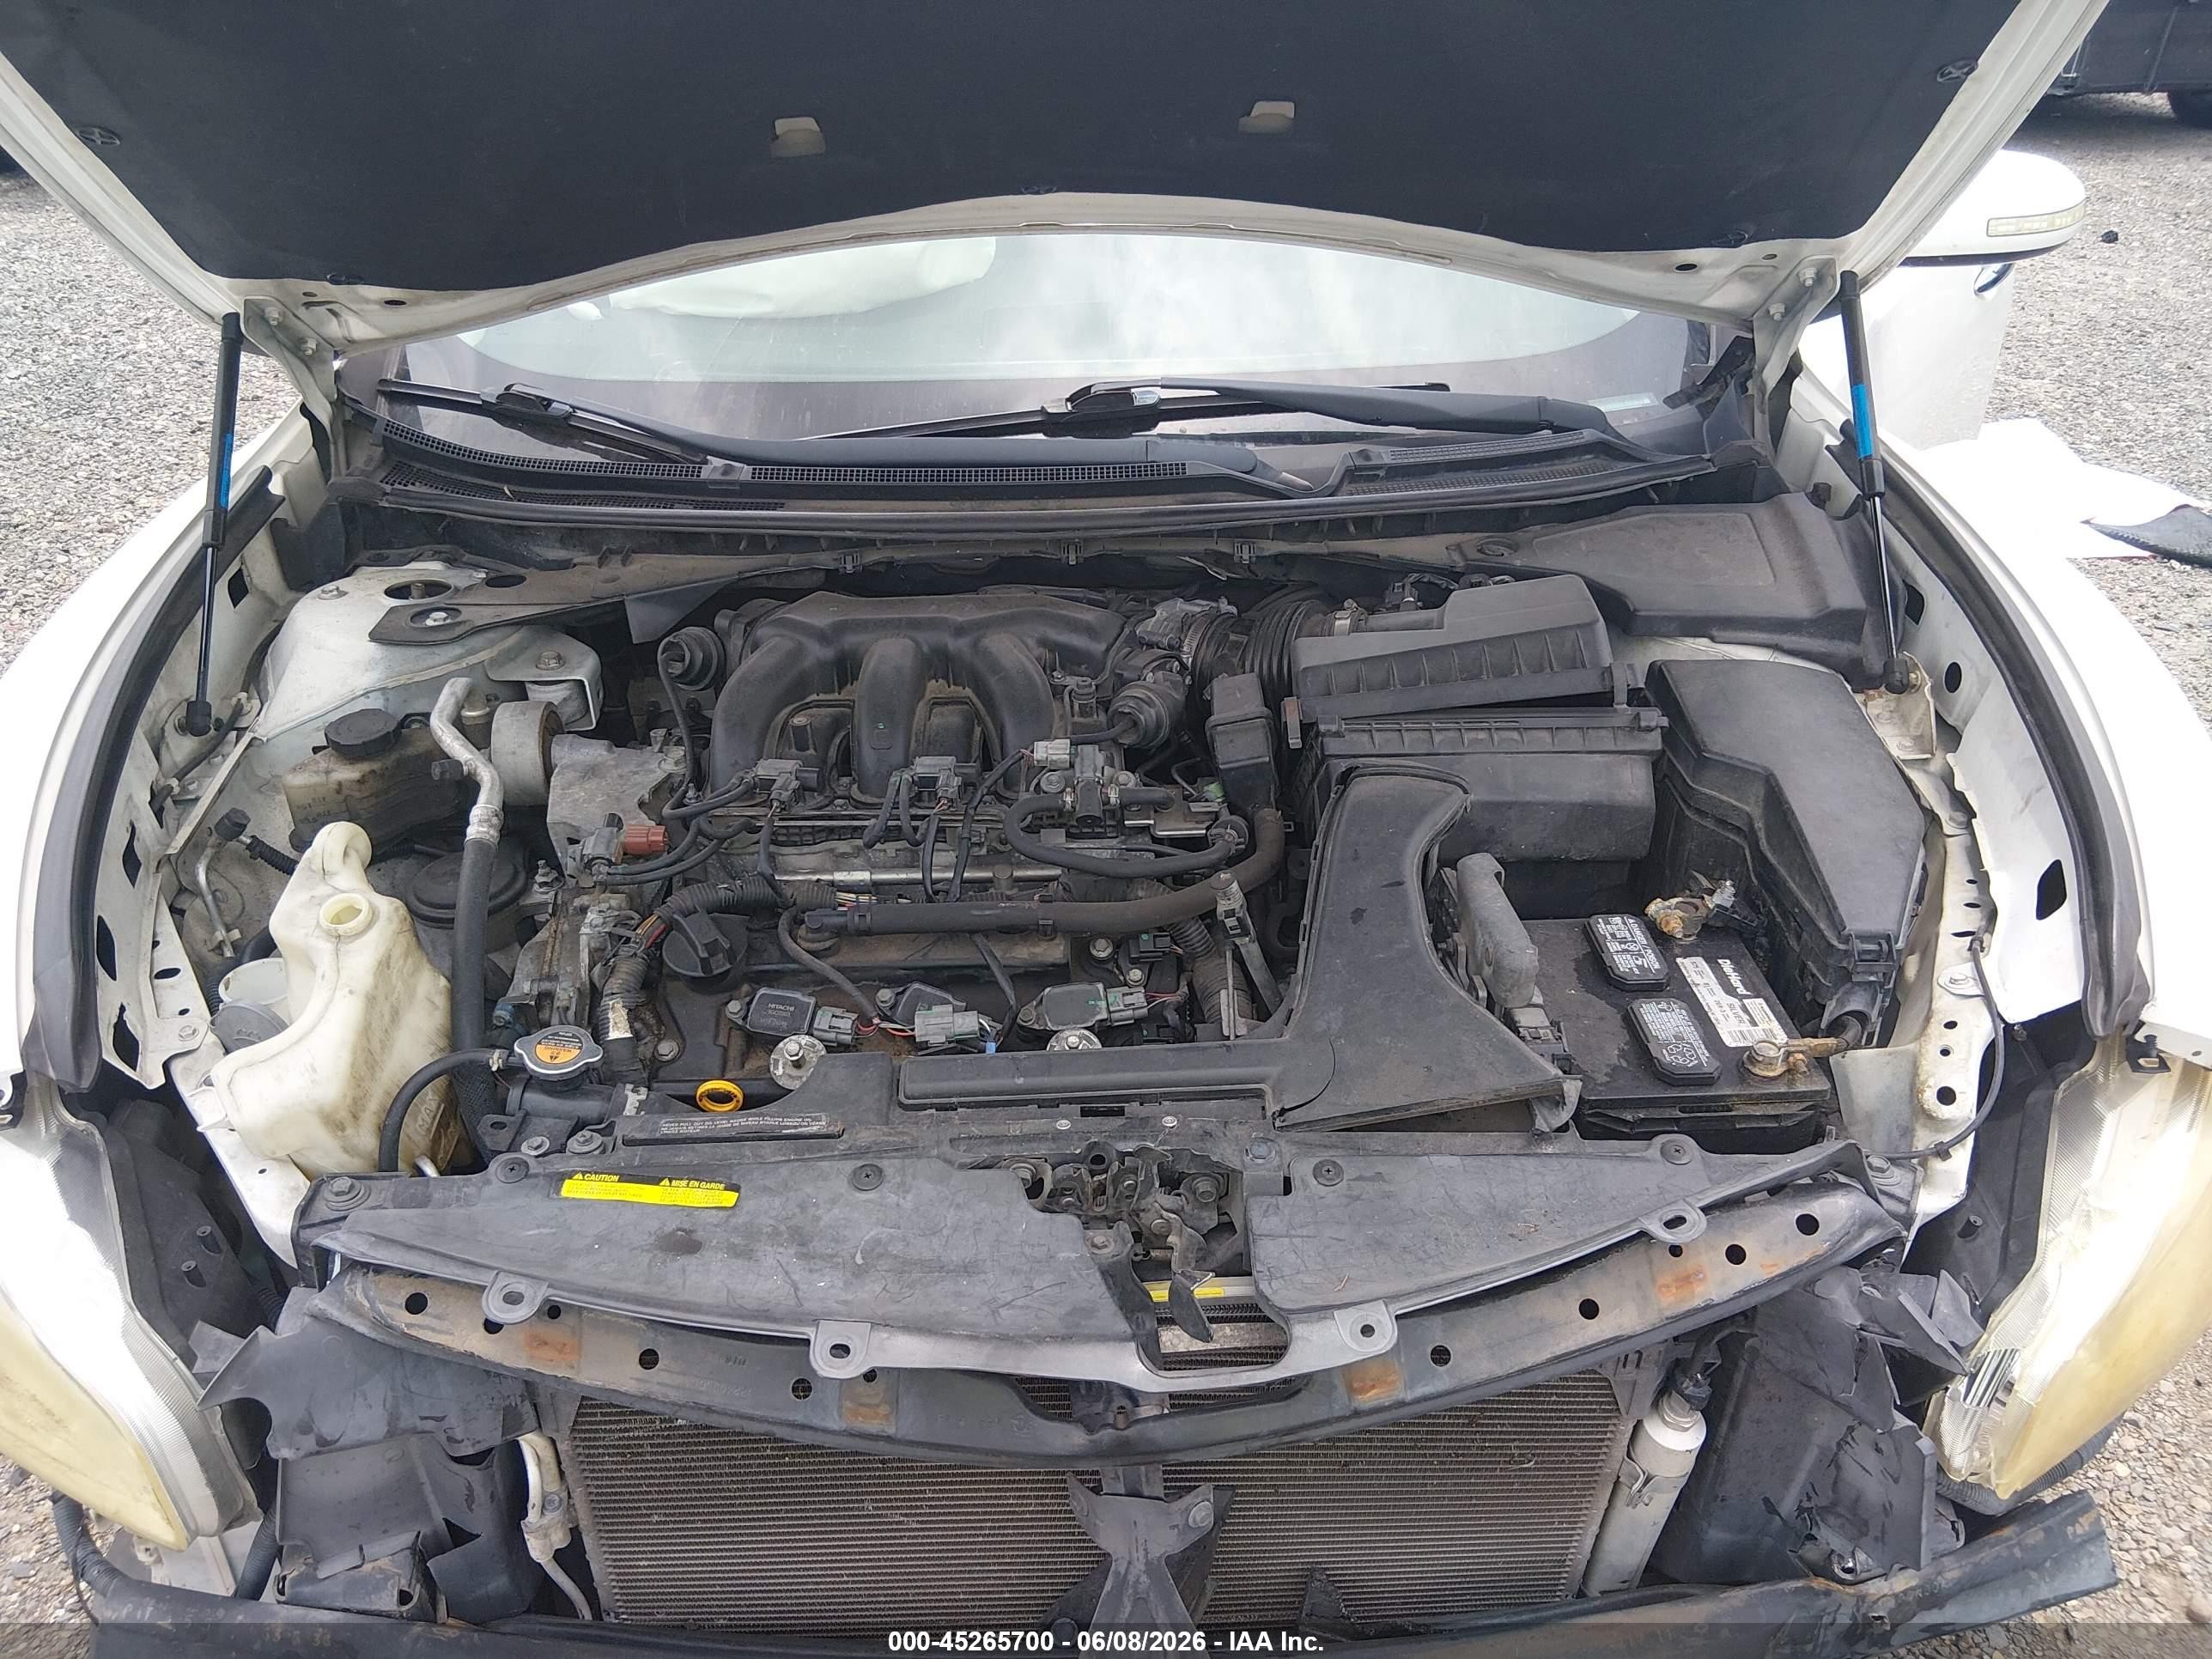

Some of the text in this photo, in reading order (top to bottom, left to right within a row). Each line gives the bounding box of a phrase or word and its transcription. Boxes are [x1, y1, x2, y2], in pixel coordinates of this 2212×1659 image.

[1631, 923, 1648, 945] DANGER
[1644, 949, 1662, 969] POISON
[1717, 958, 1753, 994] DieHard
[769, 1003, 795, 1012] HITACHI
[1726, 1001, 1746, 1024] SILVER
[416, 1091, 441, 1135] MAX
[584, 1173, 619, 1182] CAUTION
[672, 1179, 689, 1188] MISE
[700, 1182, 726, 1191] GARDE
